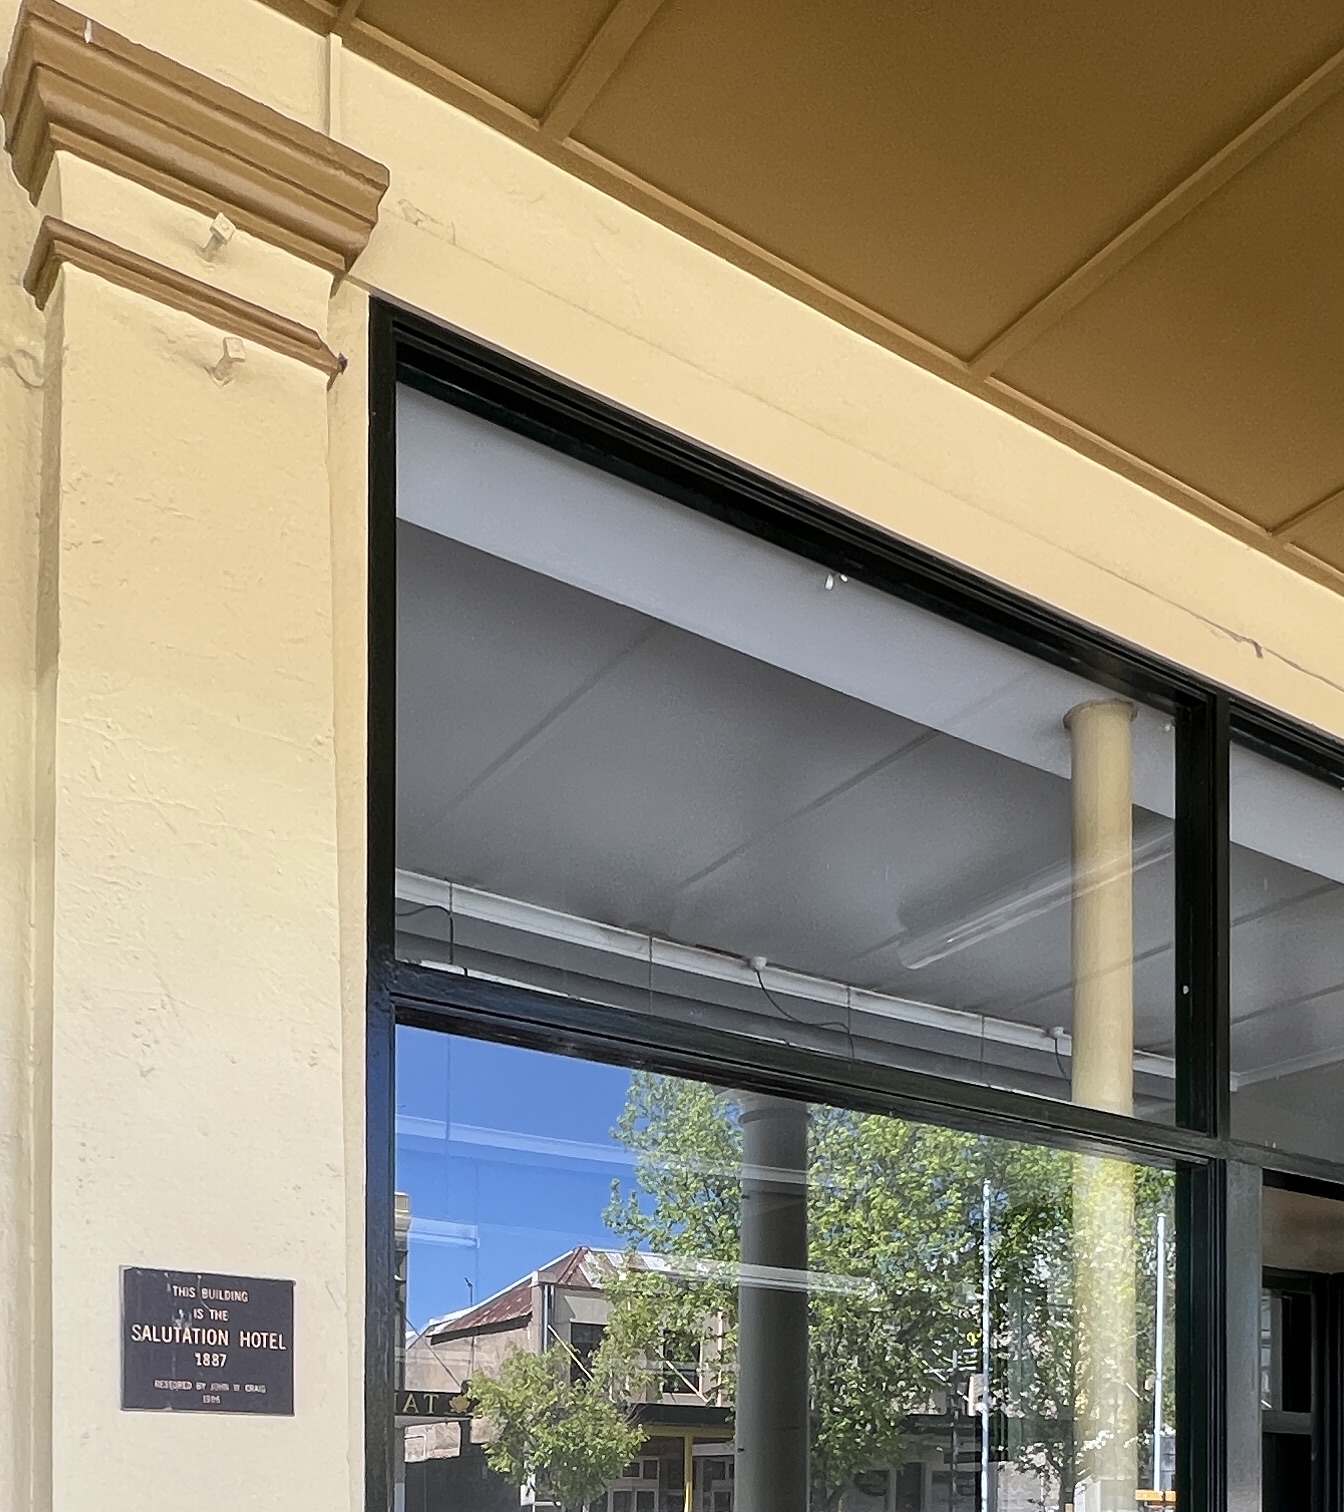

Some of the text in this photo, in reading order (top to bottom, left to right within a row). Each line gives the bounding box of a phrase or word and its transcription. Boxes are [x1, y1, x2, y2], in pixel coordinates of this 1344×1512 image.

[172, 1284, 249, 1303] THIS BUILDING
[193, 1308, 229, 1322] IS THE
[131, 1324, 287, 1351] SALUTATION HOTEL
[195, 1352, 227, 1368] 1887
